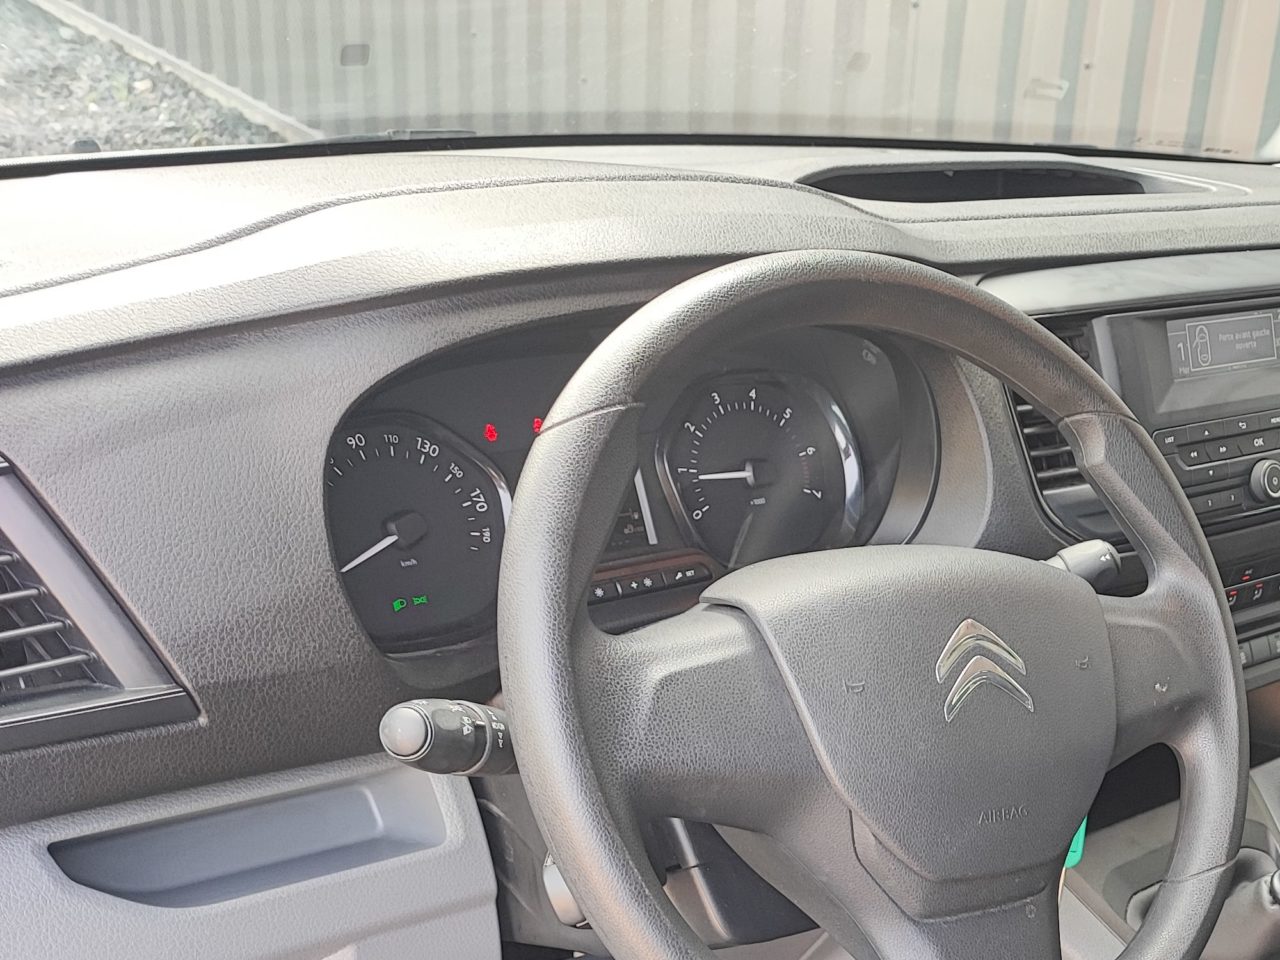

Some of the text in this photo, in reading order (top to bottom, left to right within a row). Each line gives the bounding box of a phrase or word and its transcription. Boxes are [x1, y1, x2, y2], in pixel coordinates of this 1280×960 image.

[711, 392, 720, 404] 3
[749, 388, 756, 400] 4
[783, 407, 792, 419] 5
[684, 422, 696, 433] 2
[346, 433, 366, 449] 90
[384, 434, 399, 444] 110
[1254, 438, 1264, 447] OK
[416, 437, 440, 457] 130
[806, 446, 816, 455] 6
[449, 462, 464, 479] 150
[470, 488, 488, 512] 170
[812, 489, 822, 500] 7
[692, 509, 703, 520] 0
[481, 527, 491, 543] 190
[978, 804, 1029, 825] AIRBAG
